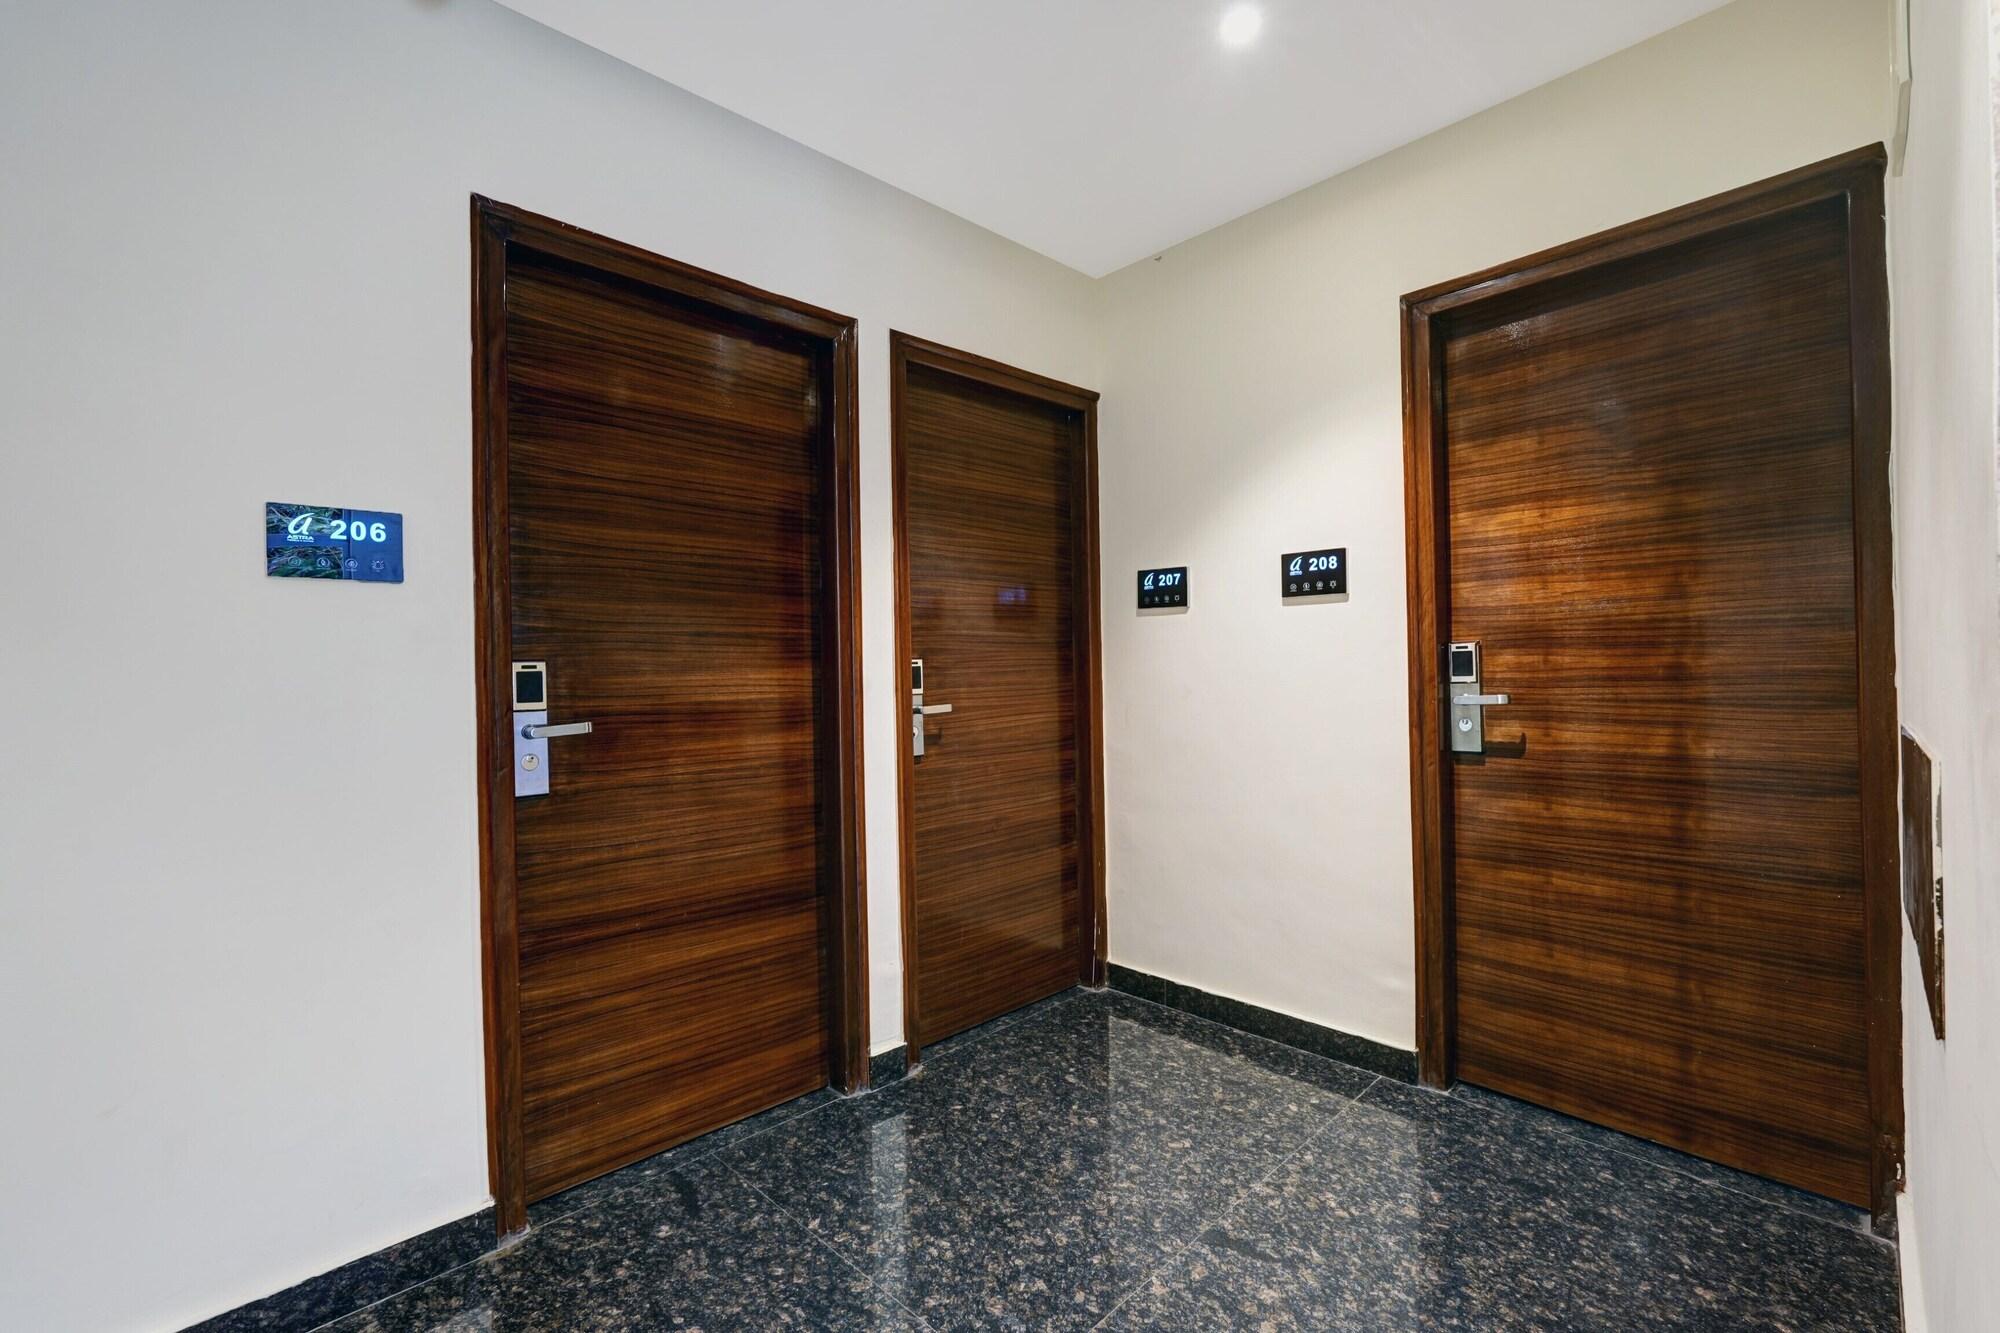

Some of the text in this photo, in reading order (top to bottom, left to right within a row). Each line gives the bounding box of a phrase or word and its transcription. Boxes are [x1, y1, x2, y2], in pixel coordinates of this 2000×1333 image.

[330, 520, 386, 542] 206
[1308, 555, 1338, 571] 208
[1158, 573, 1181, 586] 207
